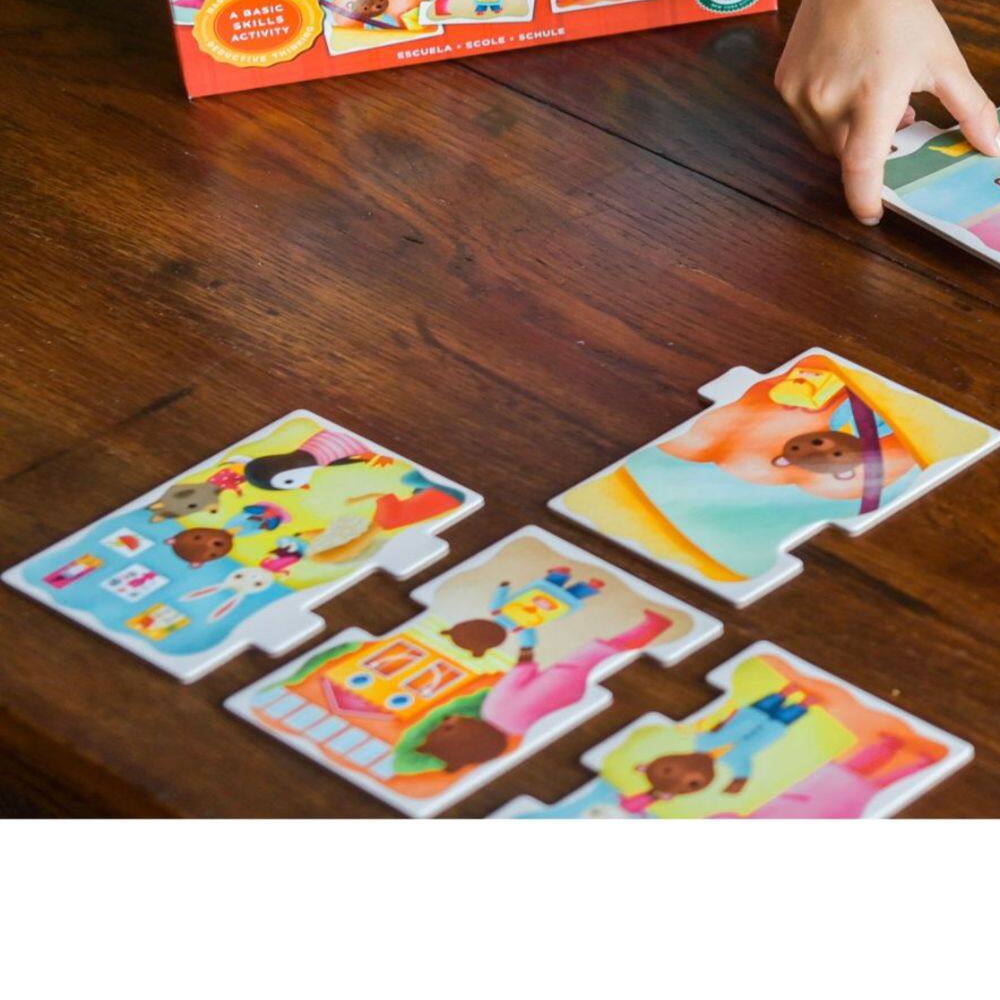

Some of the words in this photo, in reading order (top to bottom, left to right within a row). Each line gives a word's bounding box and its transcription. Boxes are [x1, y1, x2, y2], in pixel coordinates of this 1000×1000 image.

[229, 11, 238, 20] A
[243, 4, 284, 17] BASIC
[232, 15, 284, 31] SKILLS
[231, 26, 290, 43] ACTIVITY
[397, 43, 453, 60] ESCUELA
[465, 36, 507, 50] ECOLE
[518, 27, 567, 42] SCHULE
